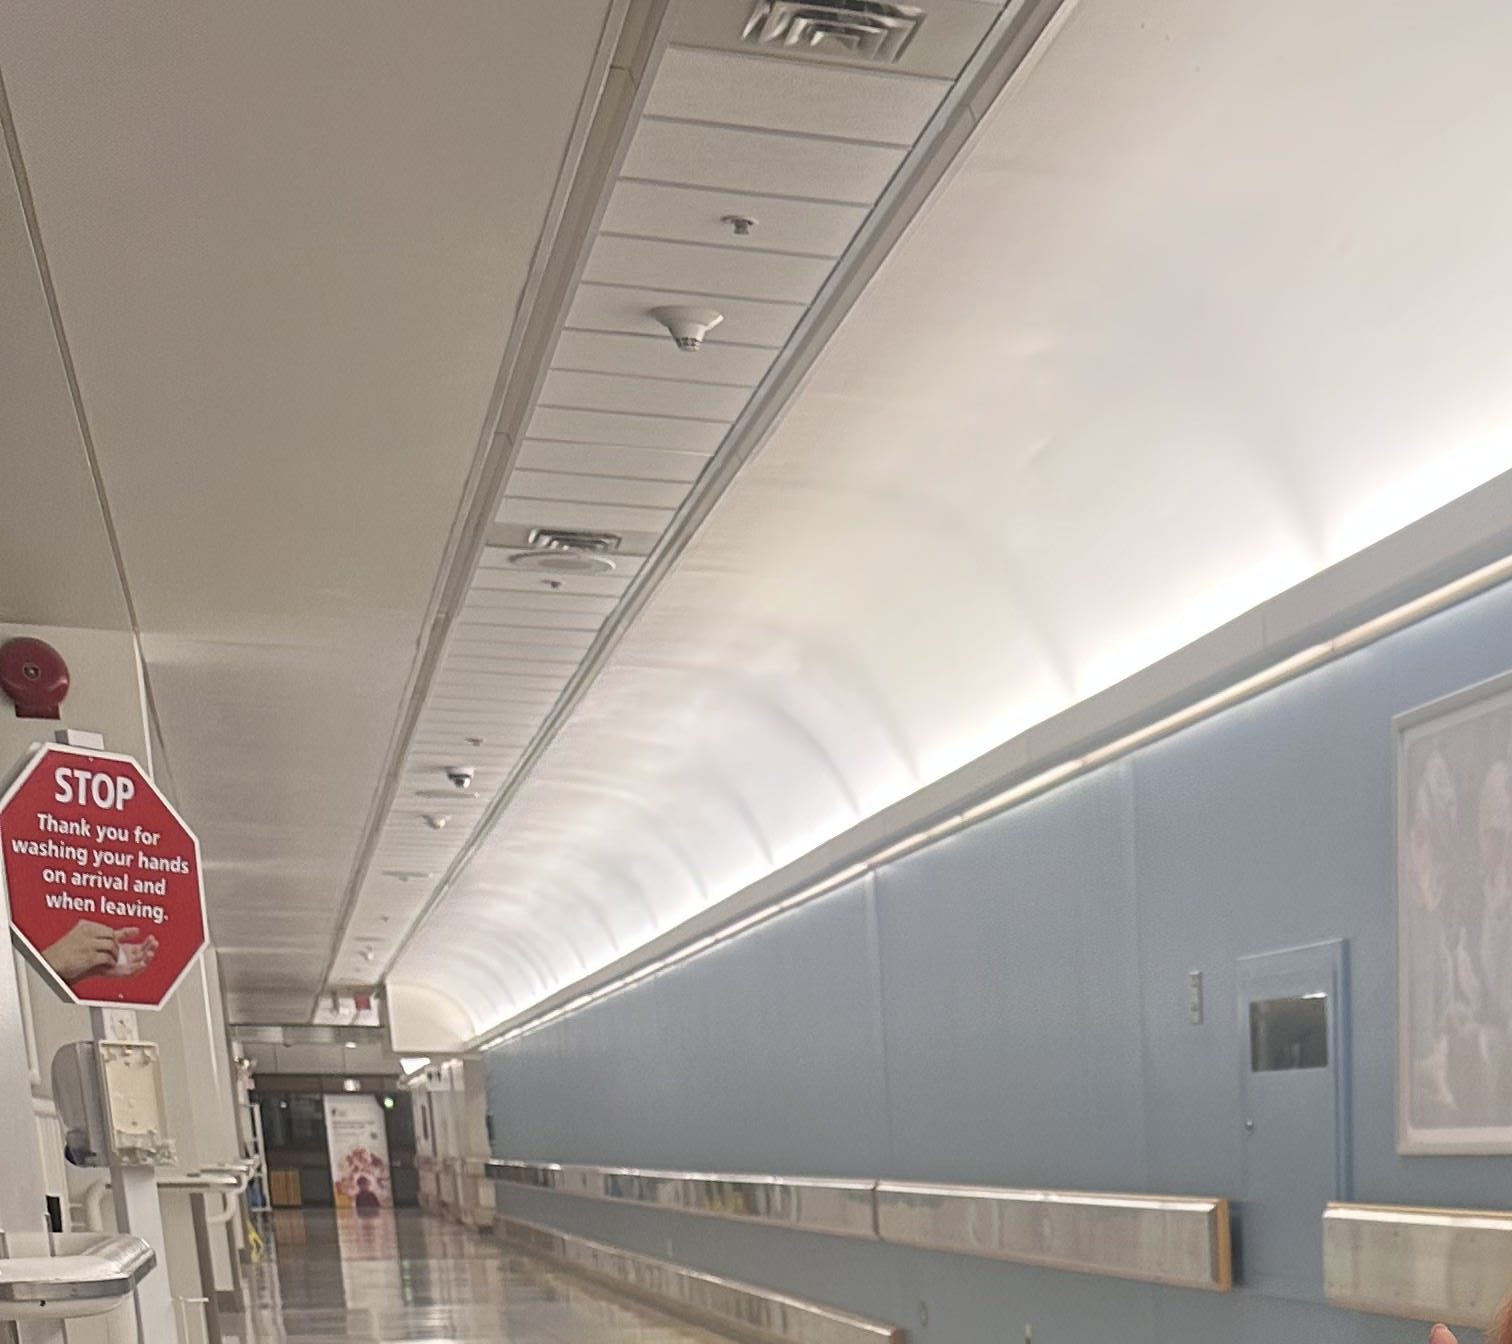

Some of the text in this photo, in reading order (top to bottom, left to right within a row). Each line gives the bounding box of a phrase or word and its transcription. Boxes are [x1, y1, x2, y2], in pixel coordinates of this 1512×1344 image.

[54, 767, 136, 810] STOP
[37, 813, 161, 846] Thank you for
[12, 839, 190, 874] washing your hands
[42, 868, 166, 896] on arrival and
[46, 892, 169, 924] when leaving.
